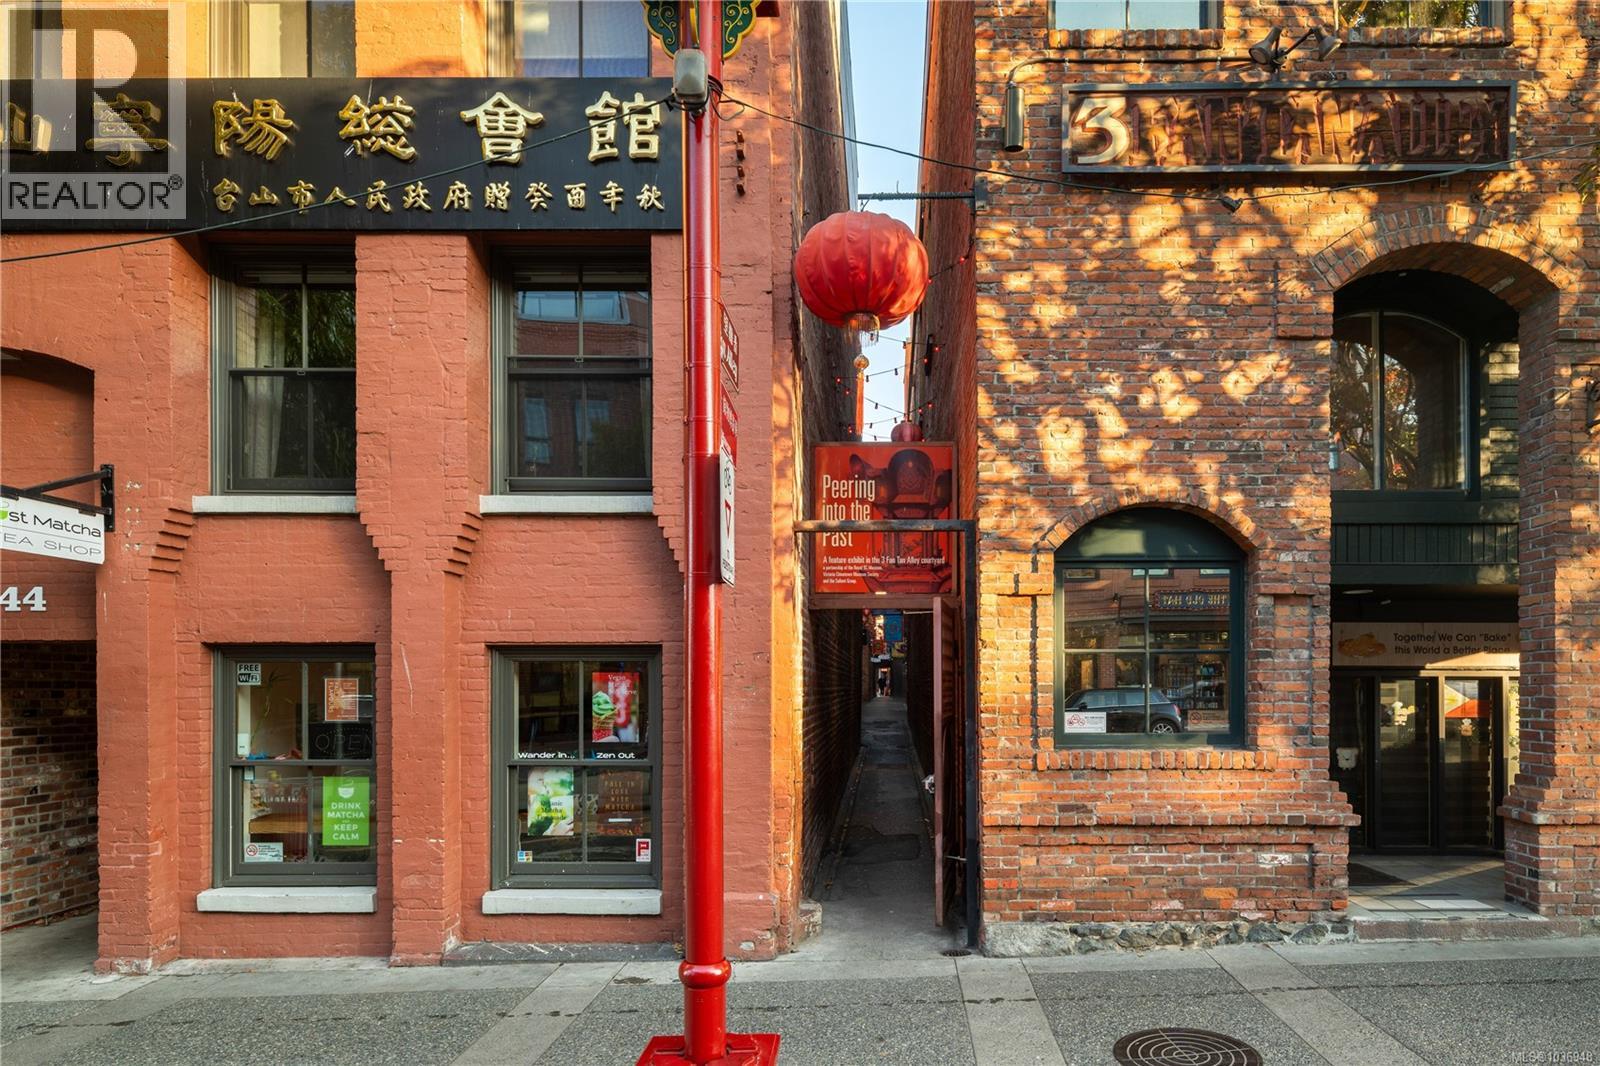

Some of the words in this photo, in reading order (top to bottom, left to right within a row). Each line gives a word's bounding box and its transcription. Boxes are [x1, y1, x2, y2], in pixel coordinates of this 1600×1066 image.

[1071, 96, 1130, 165] 3
[822, 474, 876, 501] Peering
[822, 500, 847, 521] into
[851, 500, 871, 521] the
[33, 514, 101, 538] Matcha
[43, 540, 102, 557] SHOP
[823, 556, 828, 564] A
[828, 556, 847, 564] feature
[847, 556, 865, 564] exhibit
[865, 556, 871, 564] in
[871, 556, 880, 564] the
[906, 556, 920, 566] Alley
[920, 556, 945, 566] courtyard
[1392, 632, 1435, 643] Together
[1439, 632, 1453, 642] We
[1455, 632, 1477, 642] Can
[1394, 645, 1411, 655] this
[1413, 645, 1441, 655] World
[1443, 647, 1450, 655] a
[239, 664, 260, 672] FREE
[518, 751, 556, 759] Wander
[331, 802, 361, 810] DRINK
[327, 811, 366, 819] MATCHA
[332, 832, 360, 840] CALM
